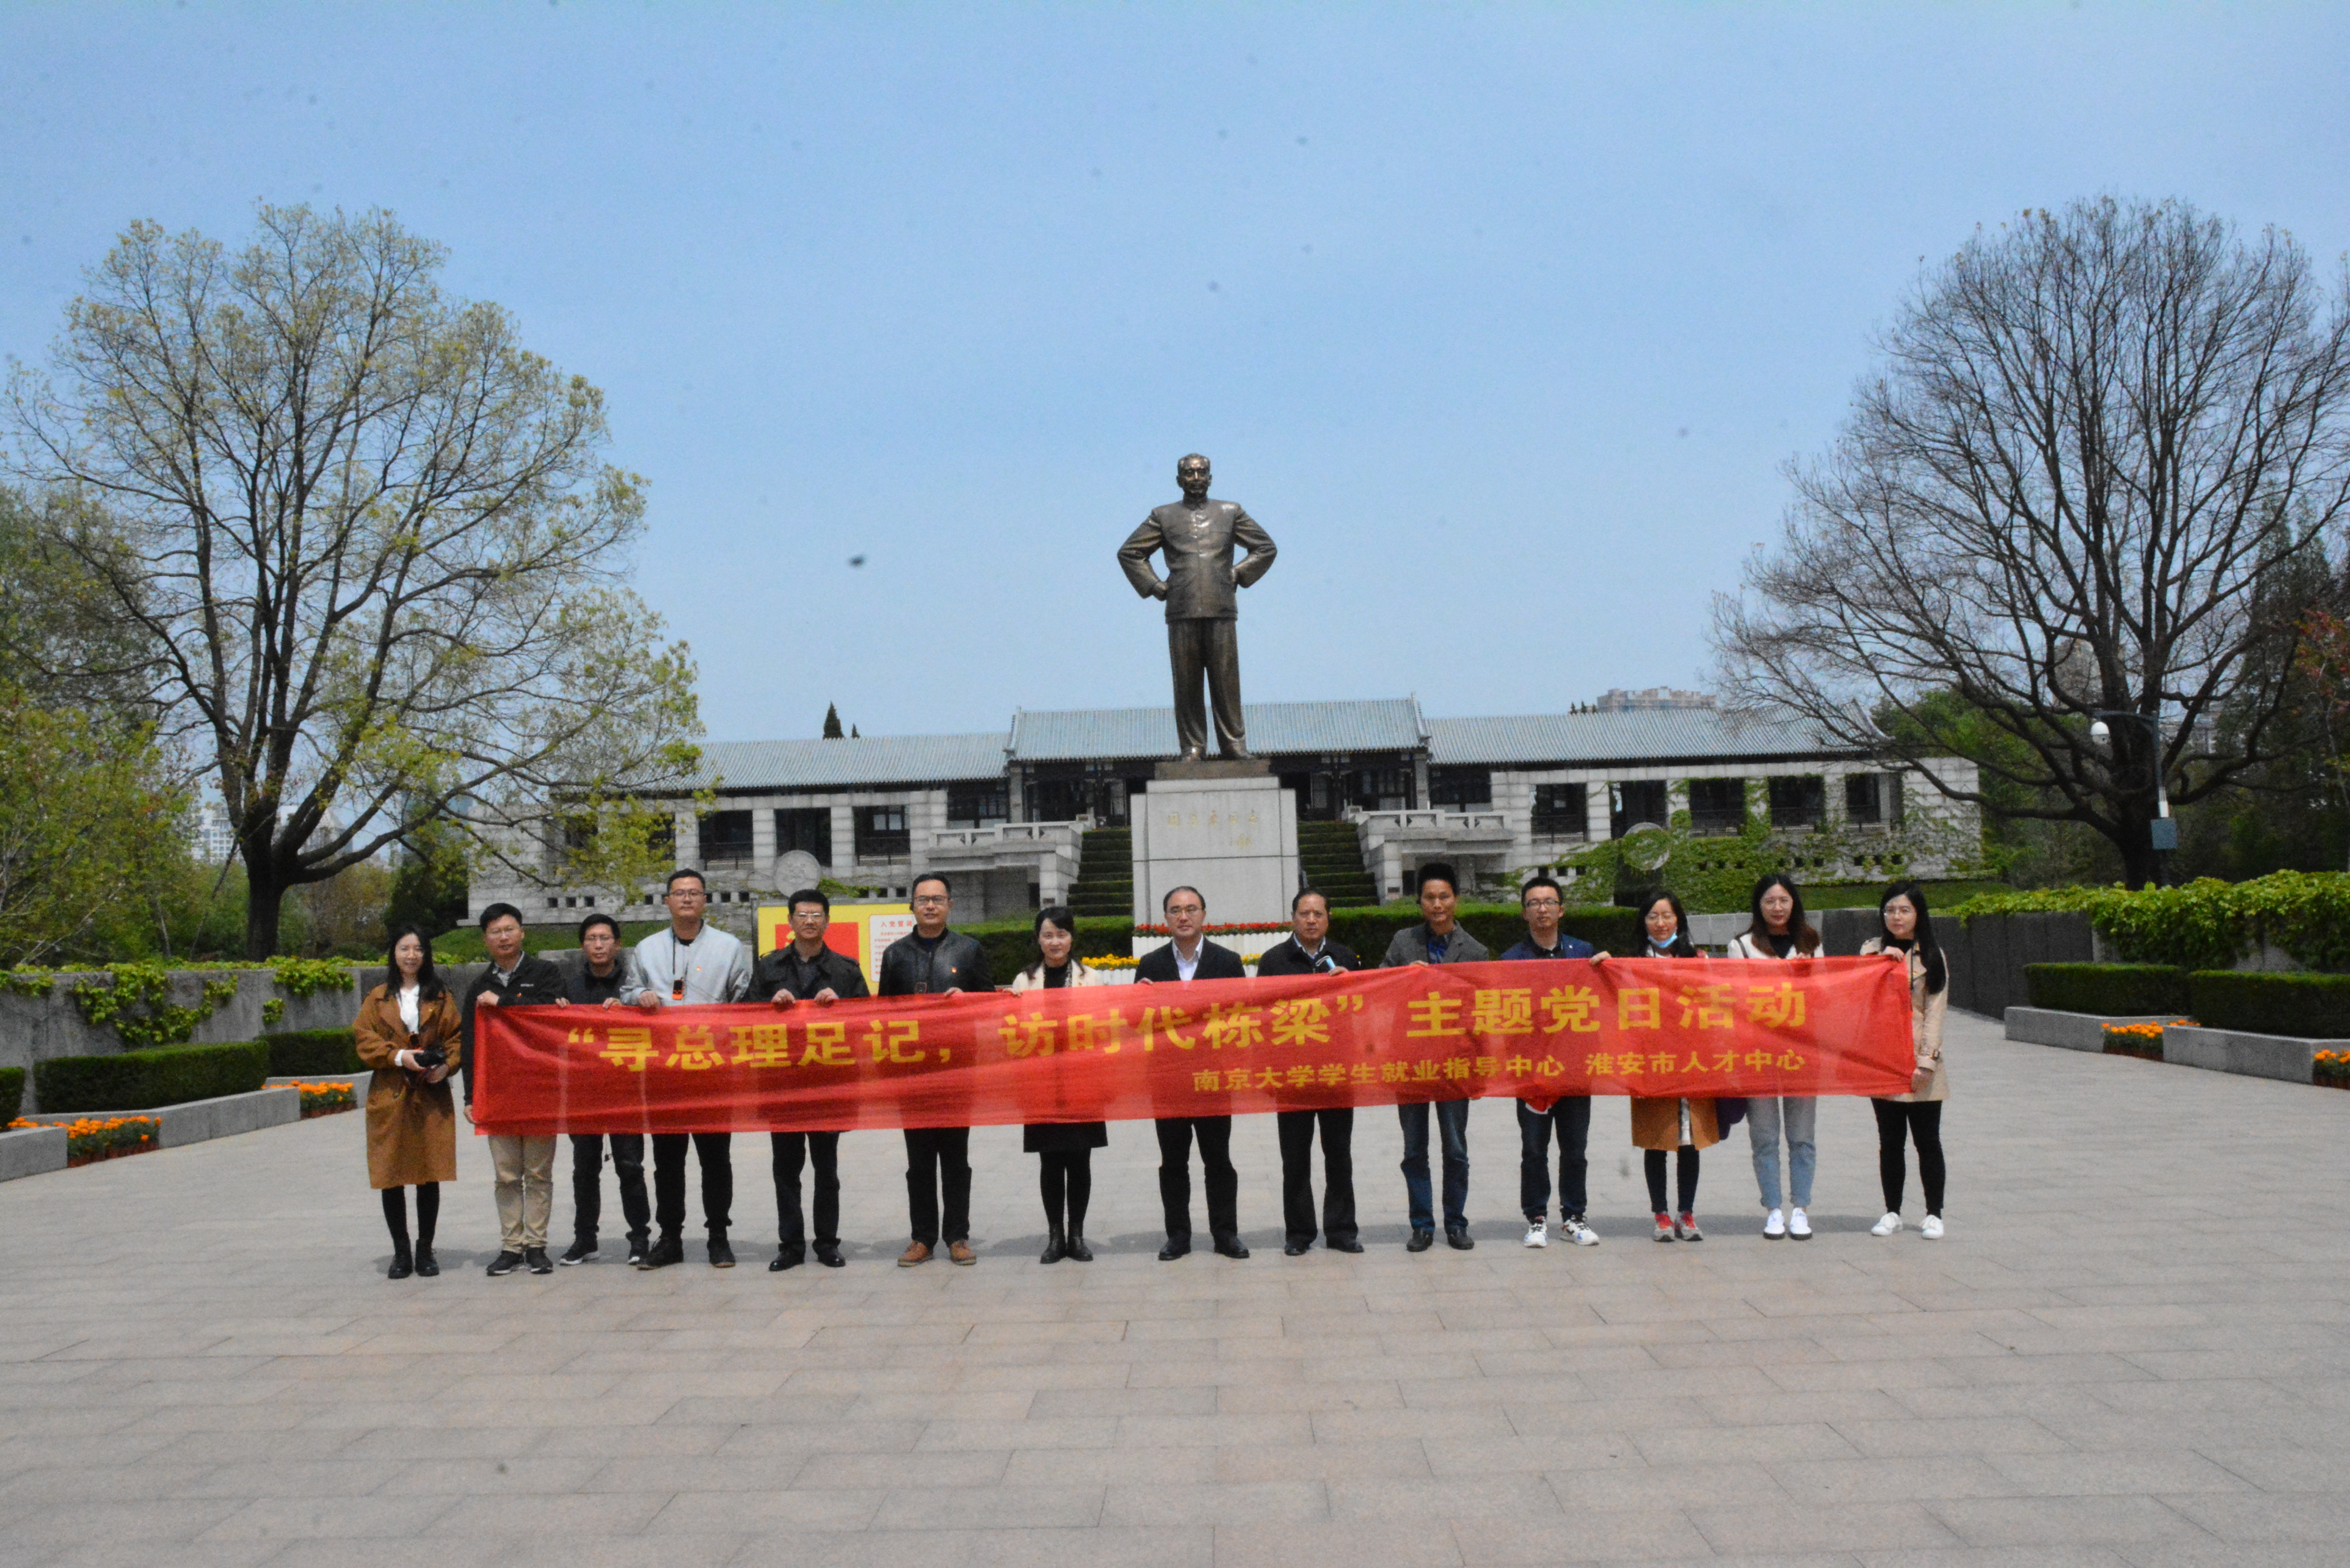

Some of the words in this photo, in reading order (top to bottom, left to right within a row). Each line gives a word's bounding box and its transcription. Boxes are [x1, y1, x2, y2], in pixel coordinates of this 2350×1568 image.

[1192, 1055, 1565, 1092] 南京大学学生就业指导中心
[1586, 1048, 1805, 1075] 淮安市人才中心
